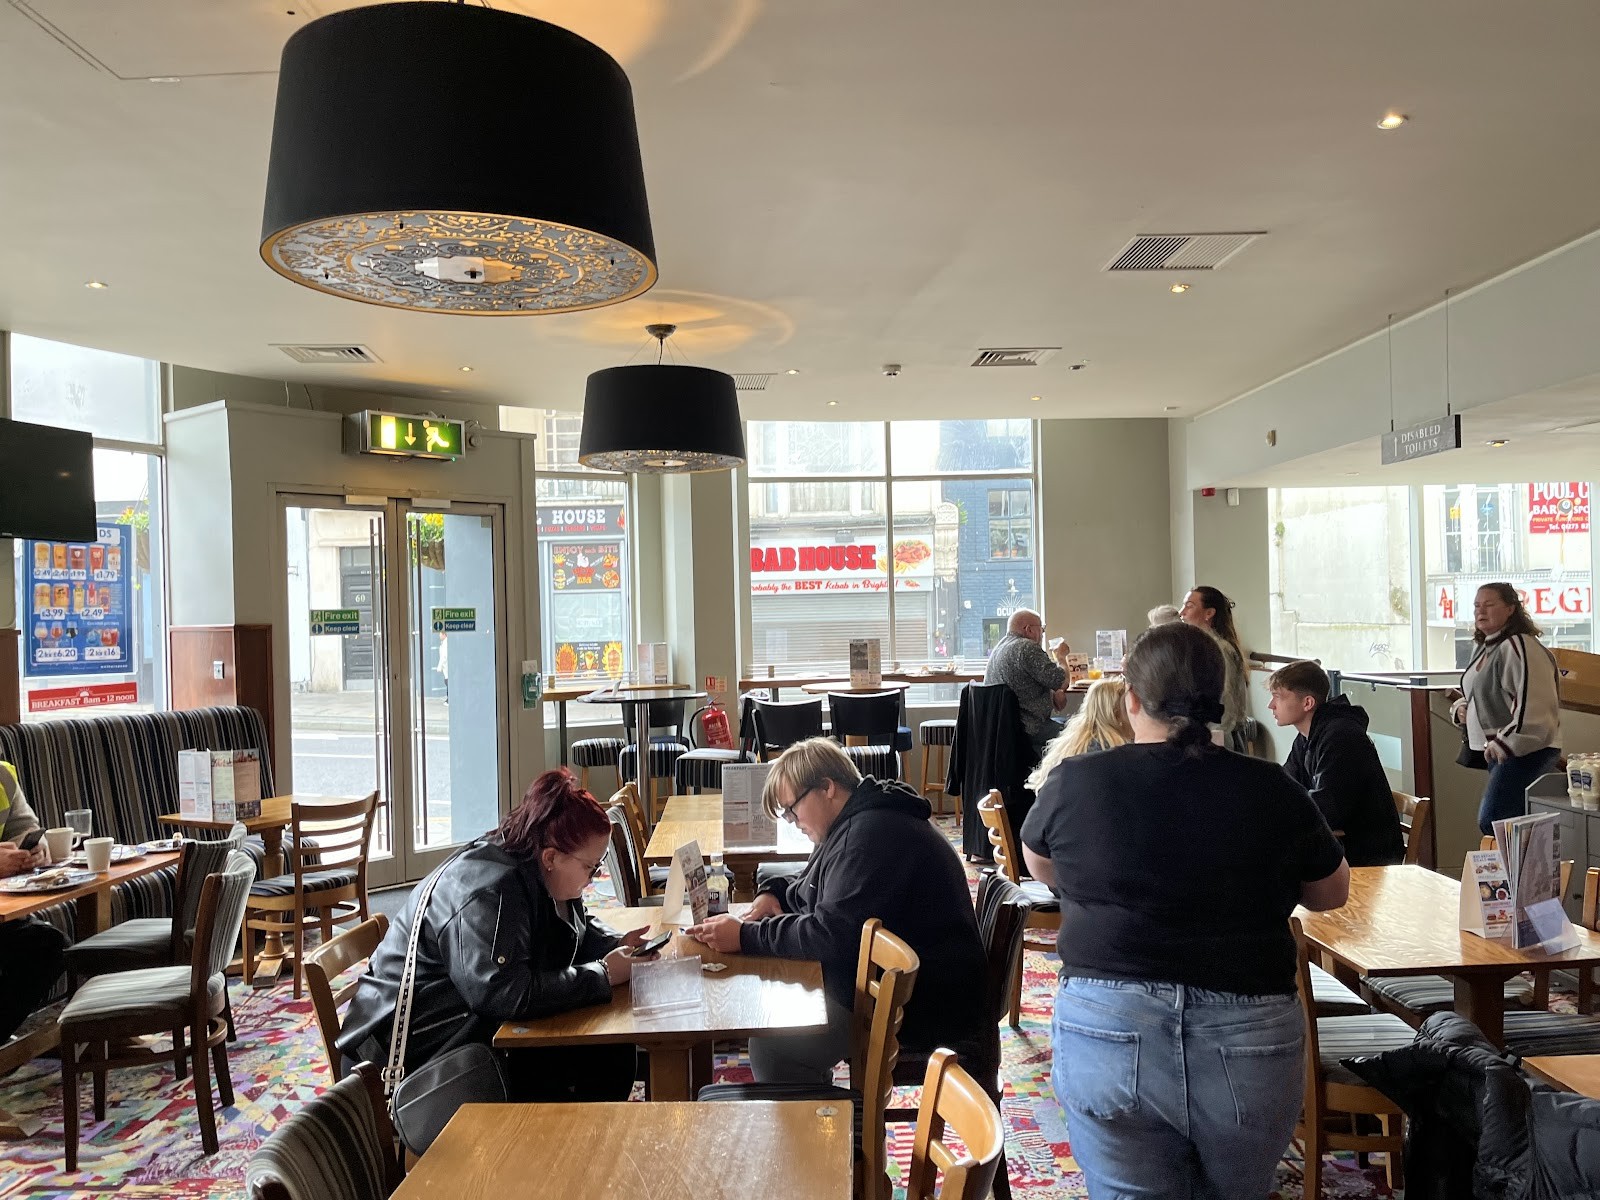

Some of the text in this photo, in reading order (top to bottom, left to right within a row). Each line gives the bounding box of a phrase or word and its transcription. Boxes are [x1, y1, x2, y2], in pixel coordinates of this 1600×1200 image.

[1402, 425, 1440, 443] DISABLED
[1404, 438, 1438, 455] TOILETS
[1533, 482, 1574, 501] POOL
[1533, 505, 1557, 515] BAR
[552, 509, 606, 524] HOUSE
[798, 545, 877, 571] HOUSE
[795, 581, 822, 590] BEST
[825, 581, 849, 590] Kebab
[852, 581, 859, 589] in
[355, 594, 366, 603] 60
[42, 609, 63, 617] £3.99
[82, 608, 103, 617] £2.49
[325, 611, 358, 620] Fire exit
[460, 610, 474, 618] exit
[38, 650, 44, 658] 2
[53, 649, 76, 658] £6.20
[104, 648, 116, 656] £16
[31, 697, 81, 709] BREAKFAST
[83, 696, 101, 704] 8am
[115, 693, 135, 701] noon
[709, 892, 719, 900] HP
